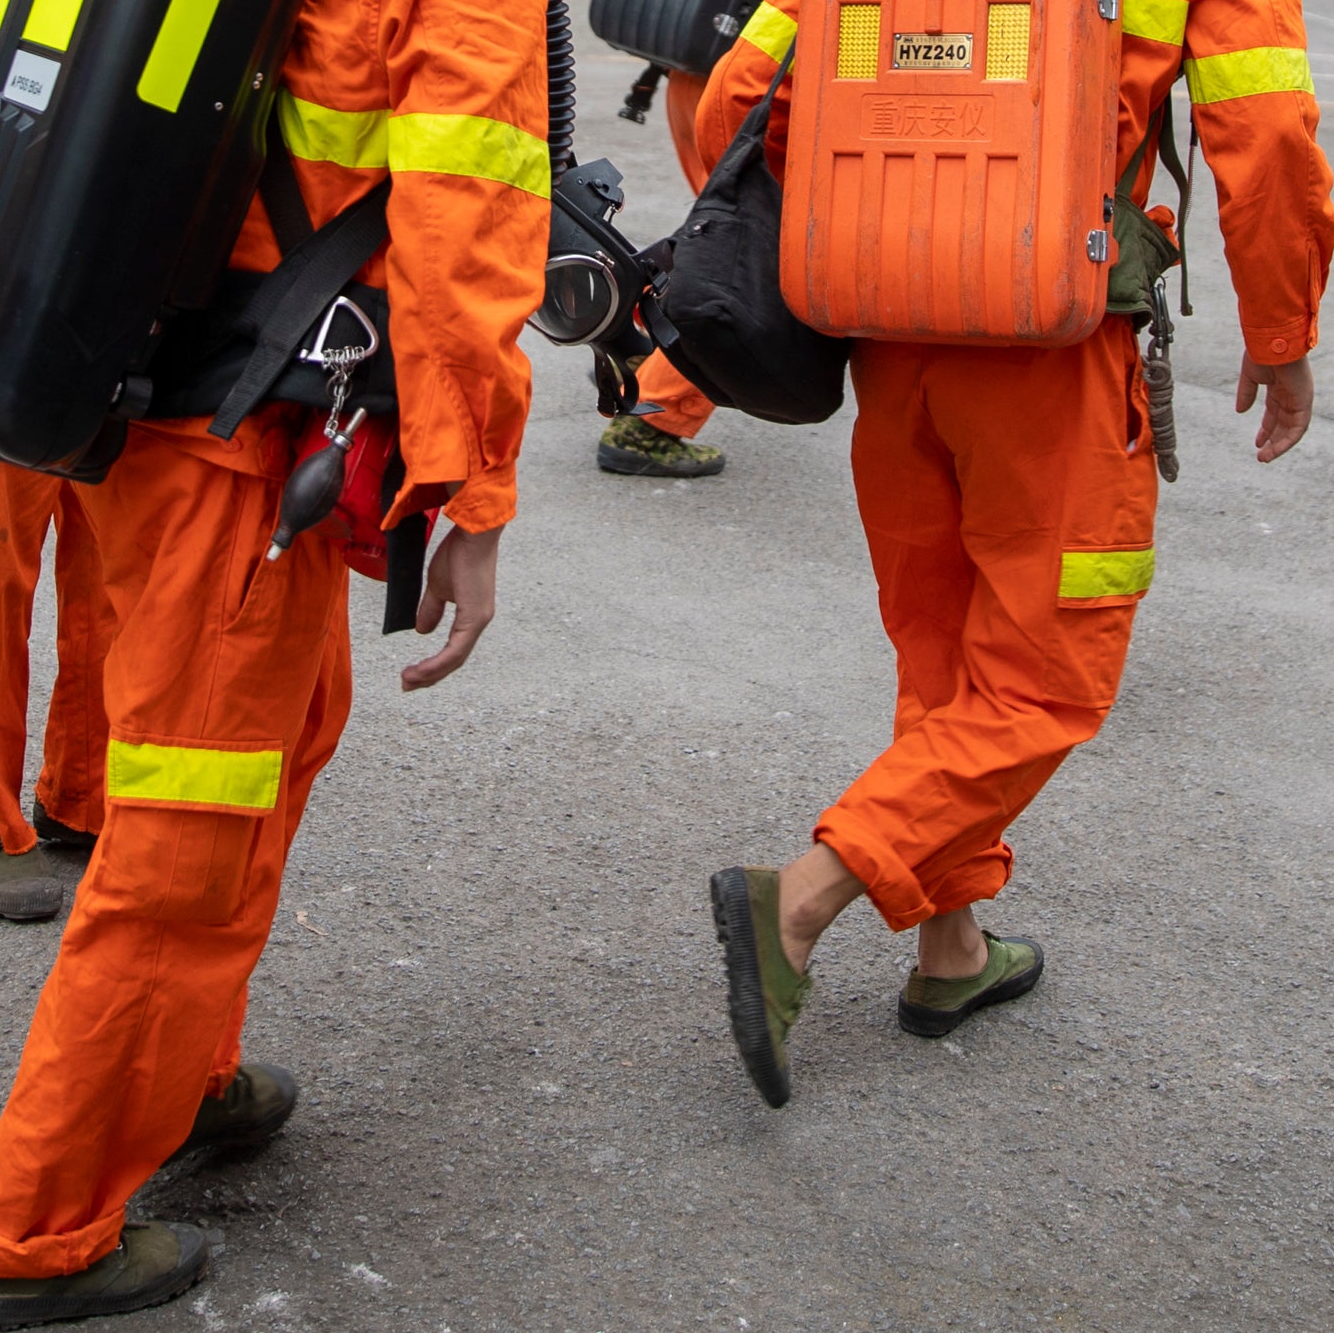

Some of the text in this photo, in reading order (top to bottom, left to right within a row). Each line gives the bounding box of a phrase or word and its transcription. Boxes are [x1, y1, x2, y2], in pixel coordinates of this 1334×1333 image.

[899, 44, 967, 60] HYZ240
[870, 98, 987, 138] 重庆安仪
